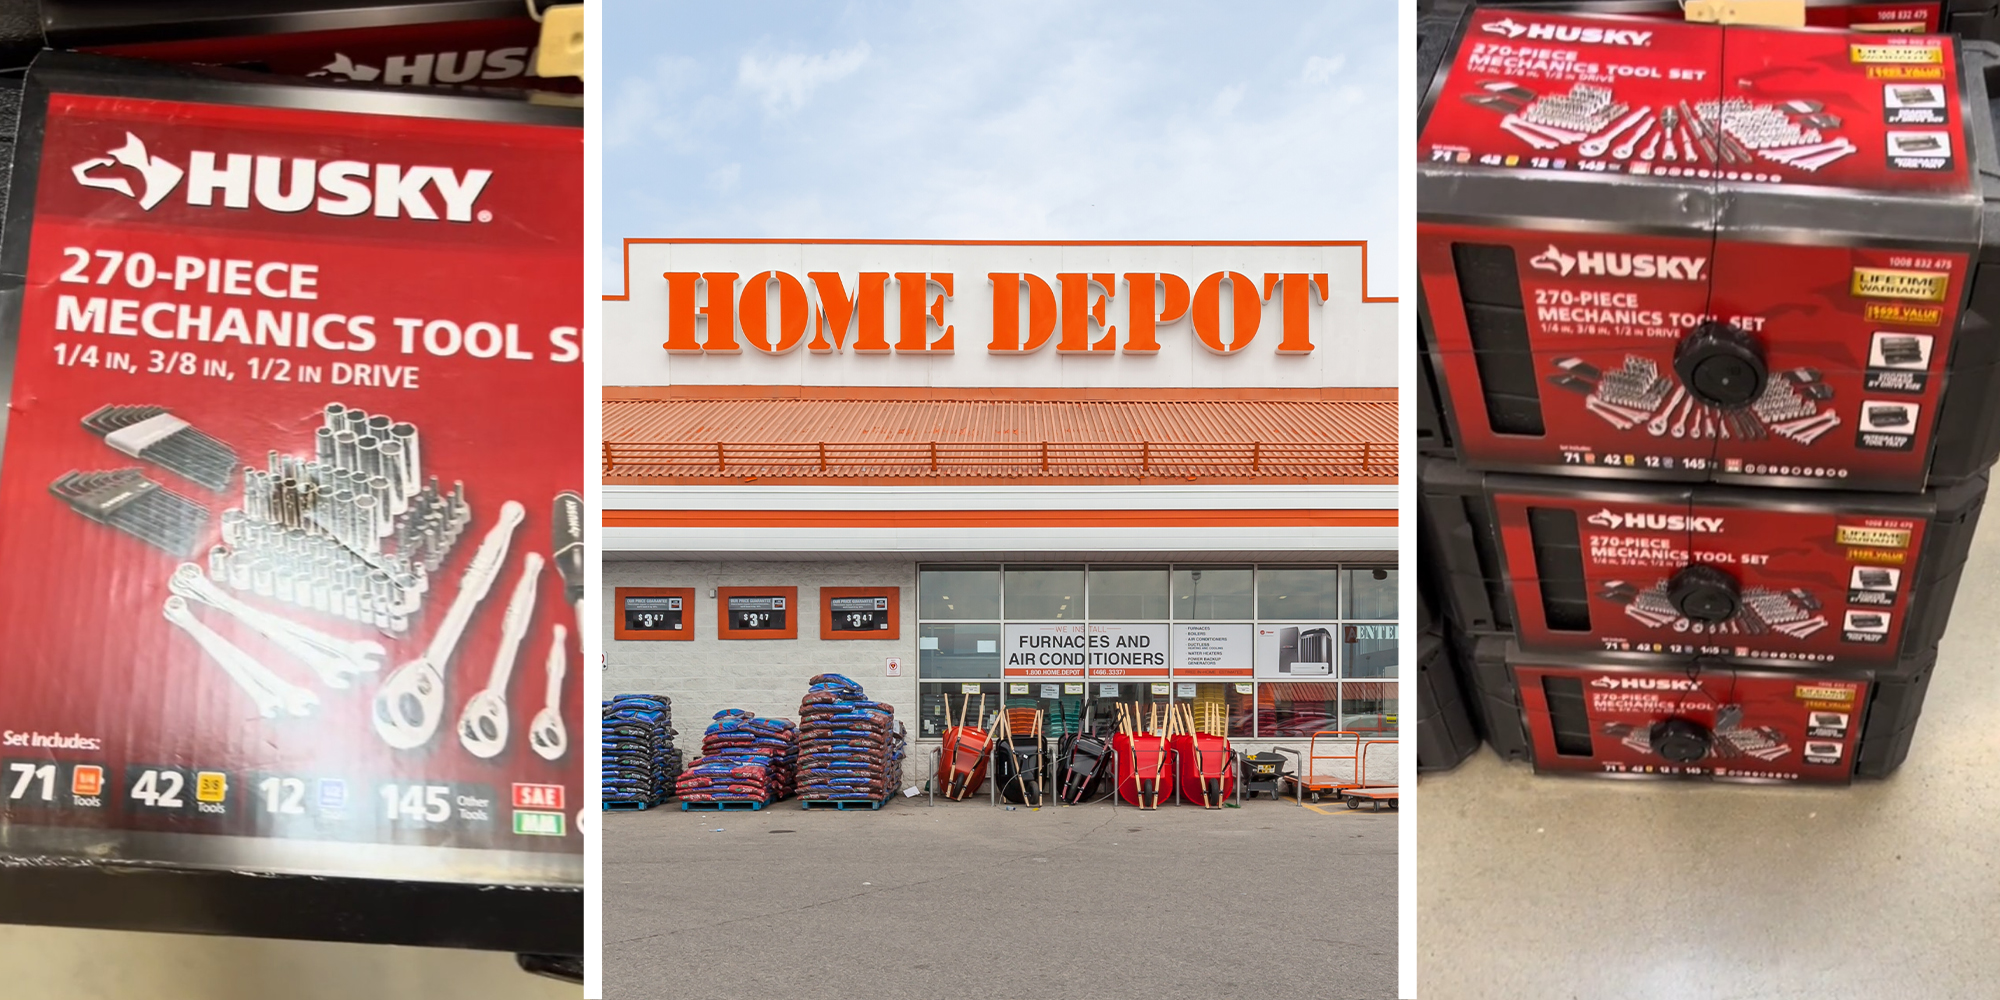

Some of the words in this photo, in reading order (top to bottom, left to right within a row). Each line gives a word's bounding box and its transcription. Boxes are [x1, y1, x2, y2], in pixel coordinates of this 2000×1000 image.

[1526, 23, 1653, 46] HUSKY
[1473, 43, 1578, 61] 270-PIECE
[383, 47, 538, 85] HUS
[1468, 53, 1600, 75] MECHANICS
[1606, 65, 1662, 78] TOOL
[1668, 66, 1706, 81] SET
[187, 151, 493, 222] HUSKY
[1577, 250, 1706, 280] HUSKY
[1889, 257, 1912, 268] 1008
[1914, 258, 1932, 269] 832
[1934, 260, 1952, 270] 475
[59, 247, 319, 300] 270-PIECE
[1859, 274, 1938, 288] LIFETIME
[1859, 284, 1938, 296] WARRANTY
[1535, 289, 1639, 308] 270-PIECE
[662, 270, 956, 355] HOME
[986, 270, 1329, 356] DEPOT
[1537, 306, 1663, 325] MECHANICS
[1730, 315, 1765, 331] SET
[55, 295, 377, 352] MECHANICS
[393, 317, 533, 361] TOOL
[549, 326, 583, 363] S
[1646, 328, 1681, 338] DRIVE
[53, 343, 99, 368] 1/4
[105, 352, 138, 374] IN,
[147, 350, 197, 375] 3/8
[203, 359, 235, 381] IN,
[247, 357, 291, 381] 1/2
[298, 365, 322, 383] IN
[331, 362, 419, 389] DRIVE
[1564, 452, 1581, 463] 71
[1603, 454, 1621, 465] 42
[1644, 456, 1660, 467] 12
[1682, 457, 1706, 470] 145
[1625, 513, 1724, 533] HUSKY
[1590, 536, 1671, 549] 270-PIECE
[1591, 548, 1689, 561] MECHANICS
[1694, 551, 1736, 563] TOOL
[1741, 553, 1770, 565] SET
[1019, 635, 1110, 649] FURNACES
[1116, 635, 1150, 648] AND
[1604, 641, 1618, 650] 71
[1637, 643, 1650, 651] 42
[1670, 644, 1682, 653] 12
[1009, 653, 1036, 665] AIR
[1040, 652, 1165, 666] CONDITIONERS
[1621, 677, 1703, 691] HUSKY
[1679, 702, 1713, 711] TOOL
[3, 730, 29, 747] Set
[31, 732, 101, 750] Includes:
[10, 763, 57, 801] 71
[131, 770, 184, 807] 42
[202, 778, 220, 791] 3/8
[72, 795, 101, 807] Tools
[259, 777, 306, 815] 12
[457, 795, 490, 808] Other
[521, 786, 557, 806] SAE
[197, 802, 225, 814] Tools
[379, 784, 452, 823] 145
[458, 807, 489, 821] Tools
